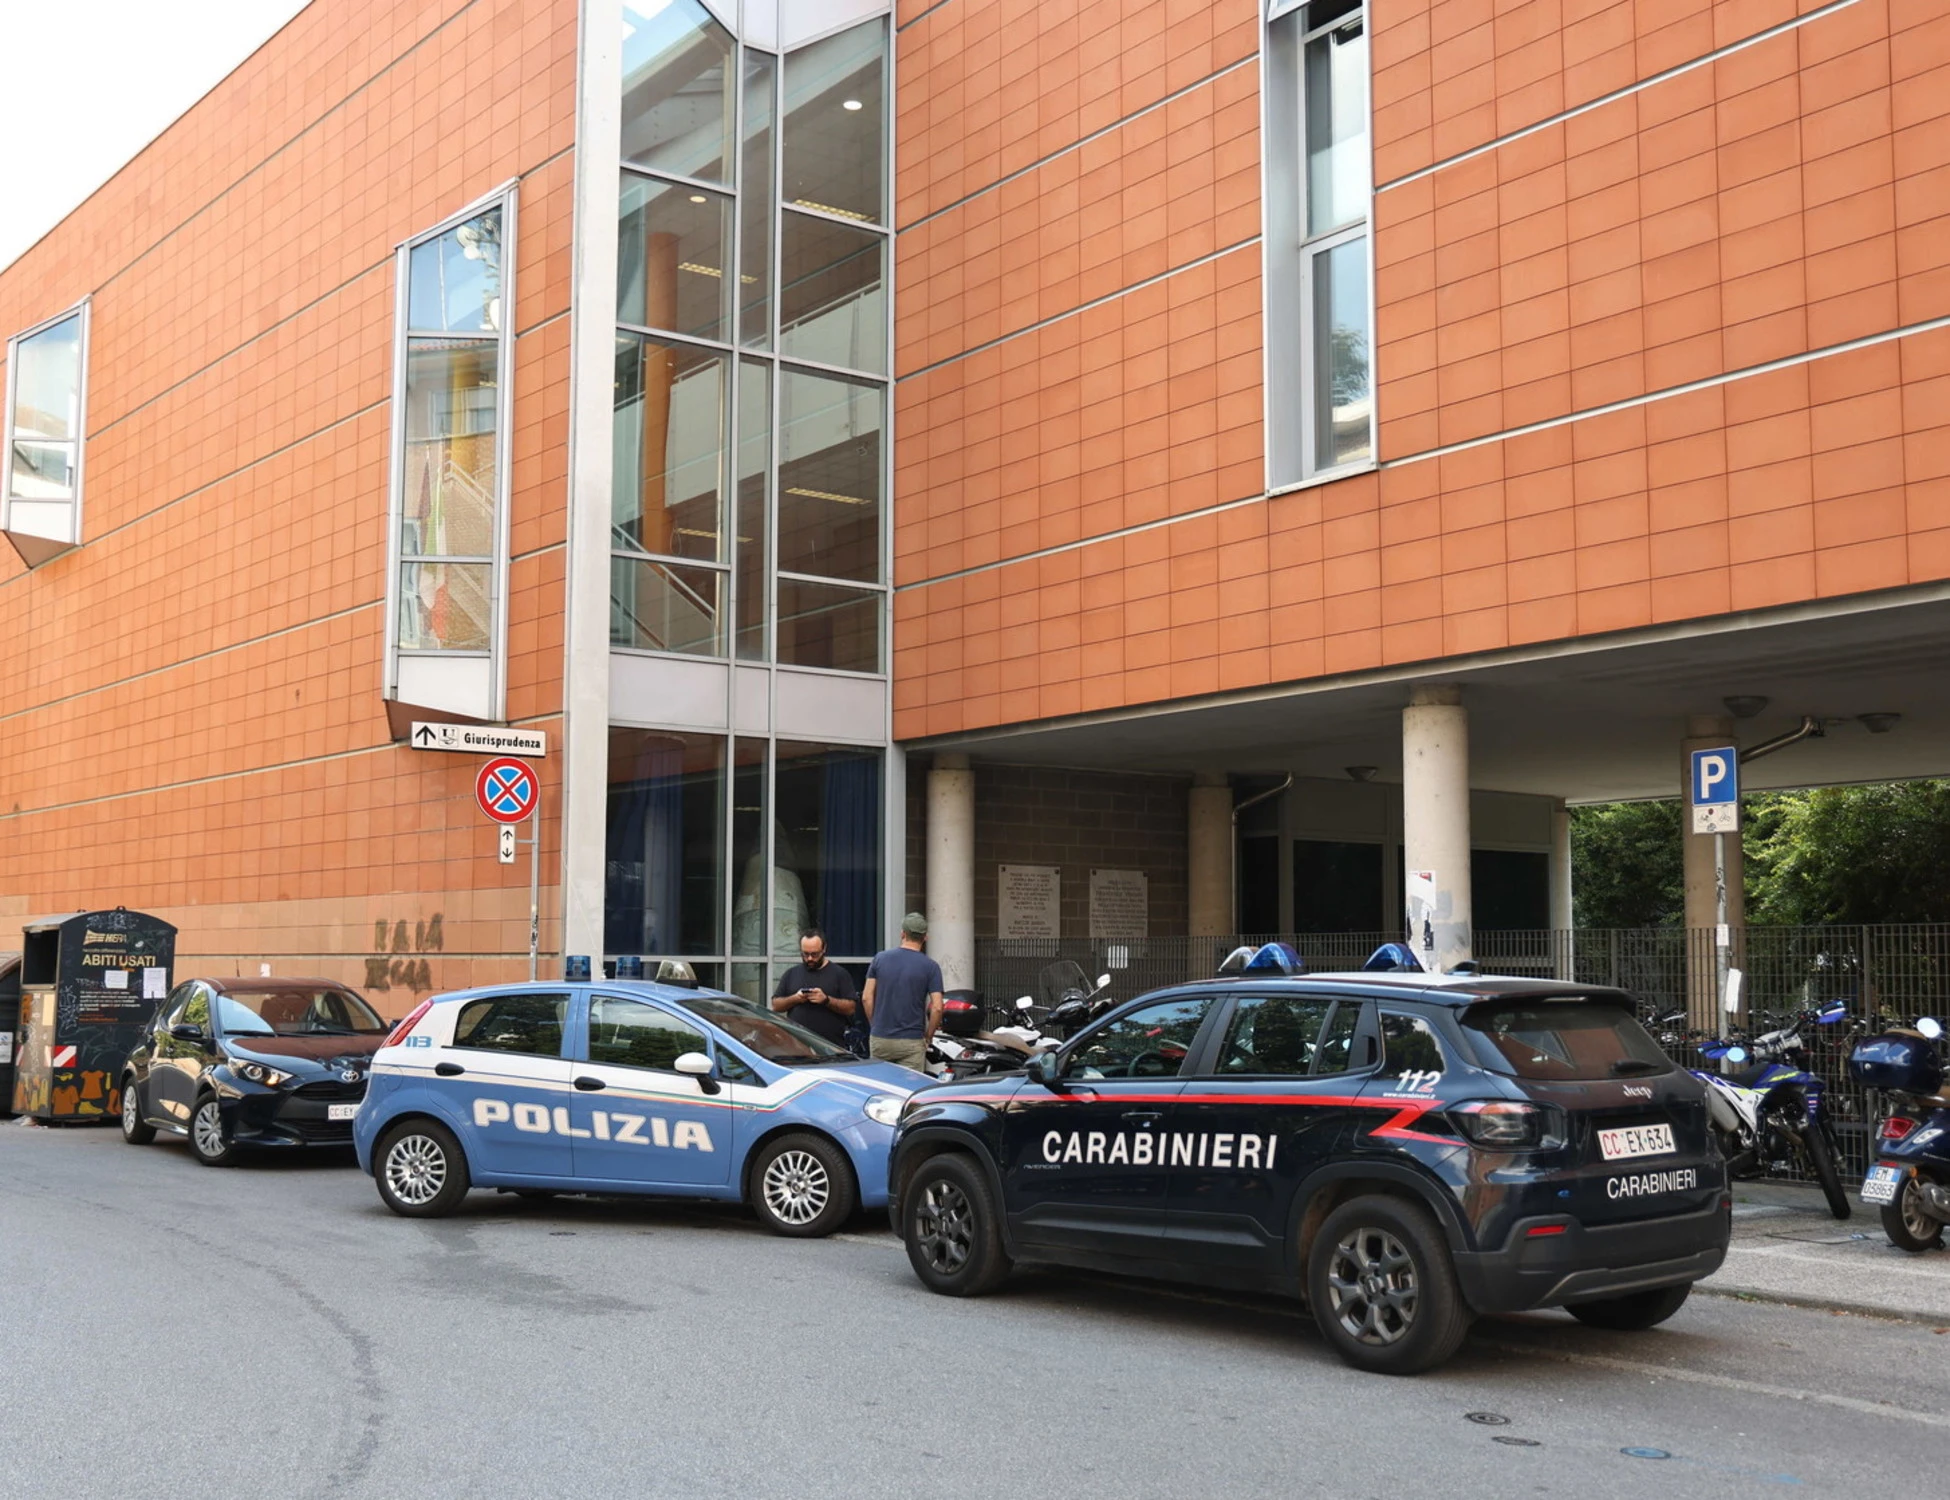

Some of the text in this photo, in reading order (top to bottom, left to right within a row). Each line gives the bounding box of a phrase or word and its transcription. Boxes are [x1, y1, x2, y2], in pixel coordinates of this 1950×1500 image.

[464, 732, 541, 749] Giurisprudenza
[1700, 755, 1727, 799] P
[82, 954, 156, 967] ABITI USATI
[405, 1035, 433, 1048] 113
[1395, 1069, 1442, 1094] 112
[1623, 1084, 1653, 1100] Jeep
[329, 1107, 340, 1118] CC
[473, 1098, 714, 1153] POLIZIA
[1042, 1130, 1278, 1170] CARABINIERI
[1602, 1127, 1672, 1156] CC EX 634
[1607, 1168, 1697, 1199] CARABINIERI
